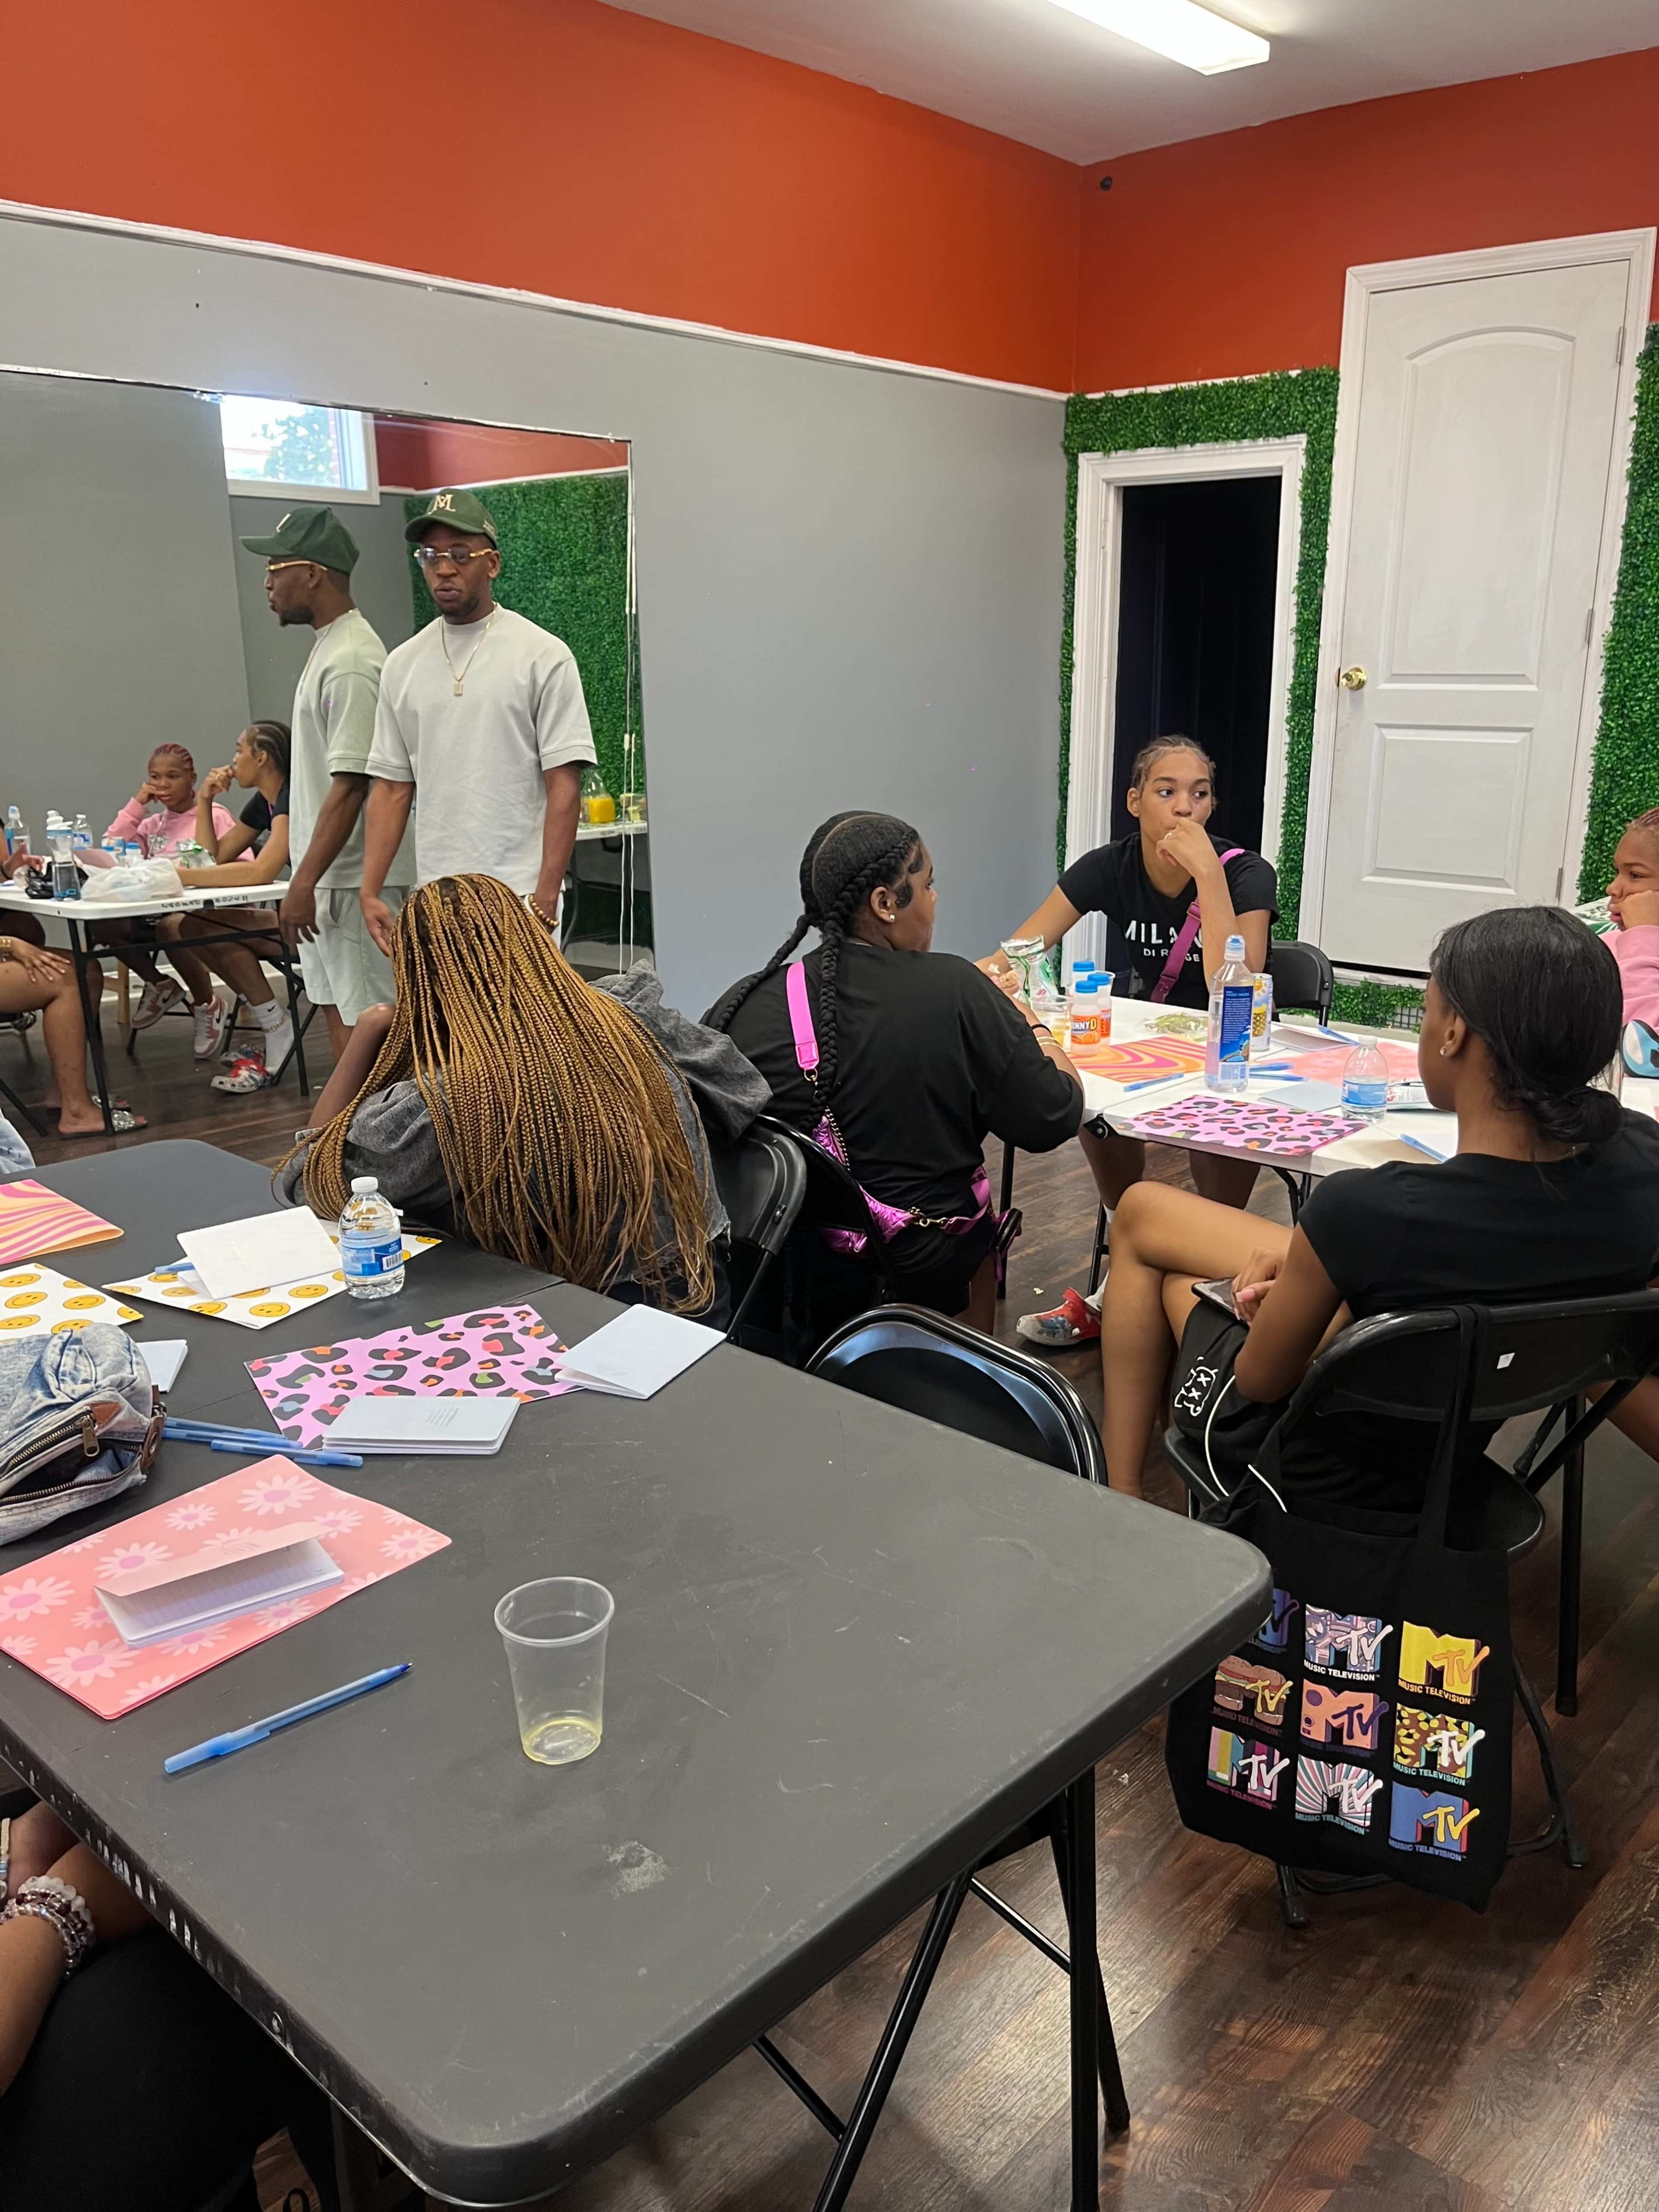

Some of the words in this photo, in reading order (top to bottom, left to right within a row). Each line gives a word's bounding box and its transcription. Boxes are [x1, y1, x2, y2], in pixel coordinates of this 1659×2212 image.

[1124, 920, 1203, 948] MILA
[1144, 948, 1155, 957] DI
[1161, 949, 1200, 962] RGE
[1071, 1017, 1097, 1031] UNNYD
[1305, 1604, 1393, 1672] MTV
[1399, 1621, 1490, 1697] MTV
[1214, 1655, 1293, 1725] MTV
[1304, 1659, 1326, 1673] MUSIC
[1328, 1669, 1375, 1681] TELEVISION
[1398, 1679, 1423, 1693] MUSIC
[1425, 1686, 1470, 1704] TELEVISION
[1300, 1678, 1389, 1749] MTV
[1208, 1726, 1290, 1801] MTV
[1393, 1702, 1485, 1779] MTV
[1295, 1754, 1383, 1827] MTV
[1393, 1761, 1417, 1775] MUSIC
[1419, 1769, 1465, 1786] TELEVISION
[1295, 1812, 1320, 1821] MUSIC
[1322, 1814, 1364, 1835] TELEVISION
[1390, 1780, 1480, 1852] MTV
[1388, 1837, 1413, 1851] MUSIC
[1415, 1844, 1462, 1862] TELEVISION
